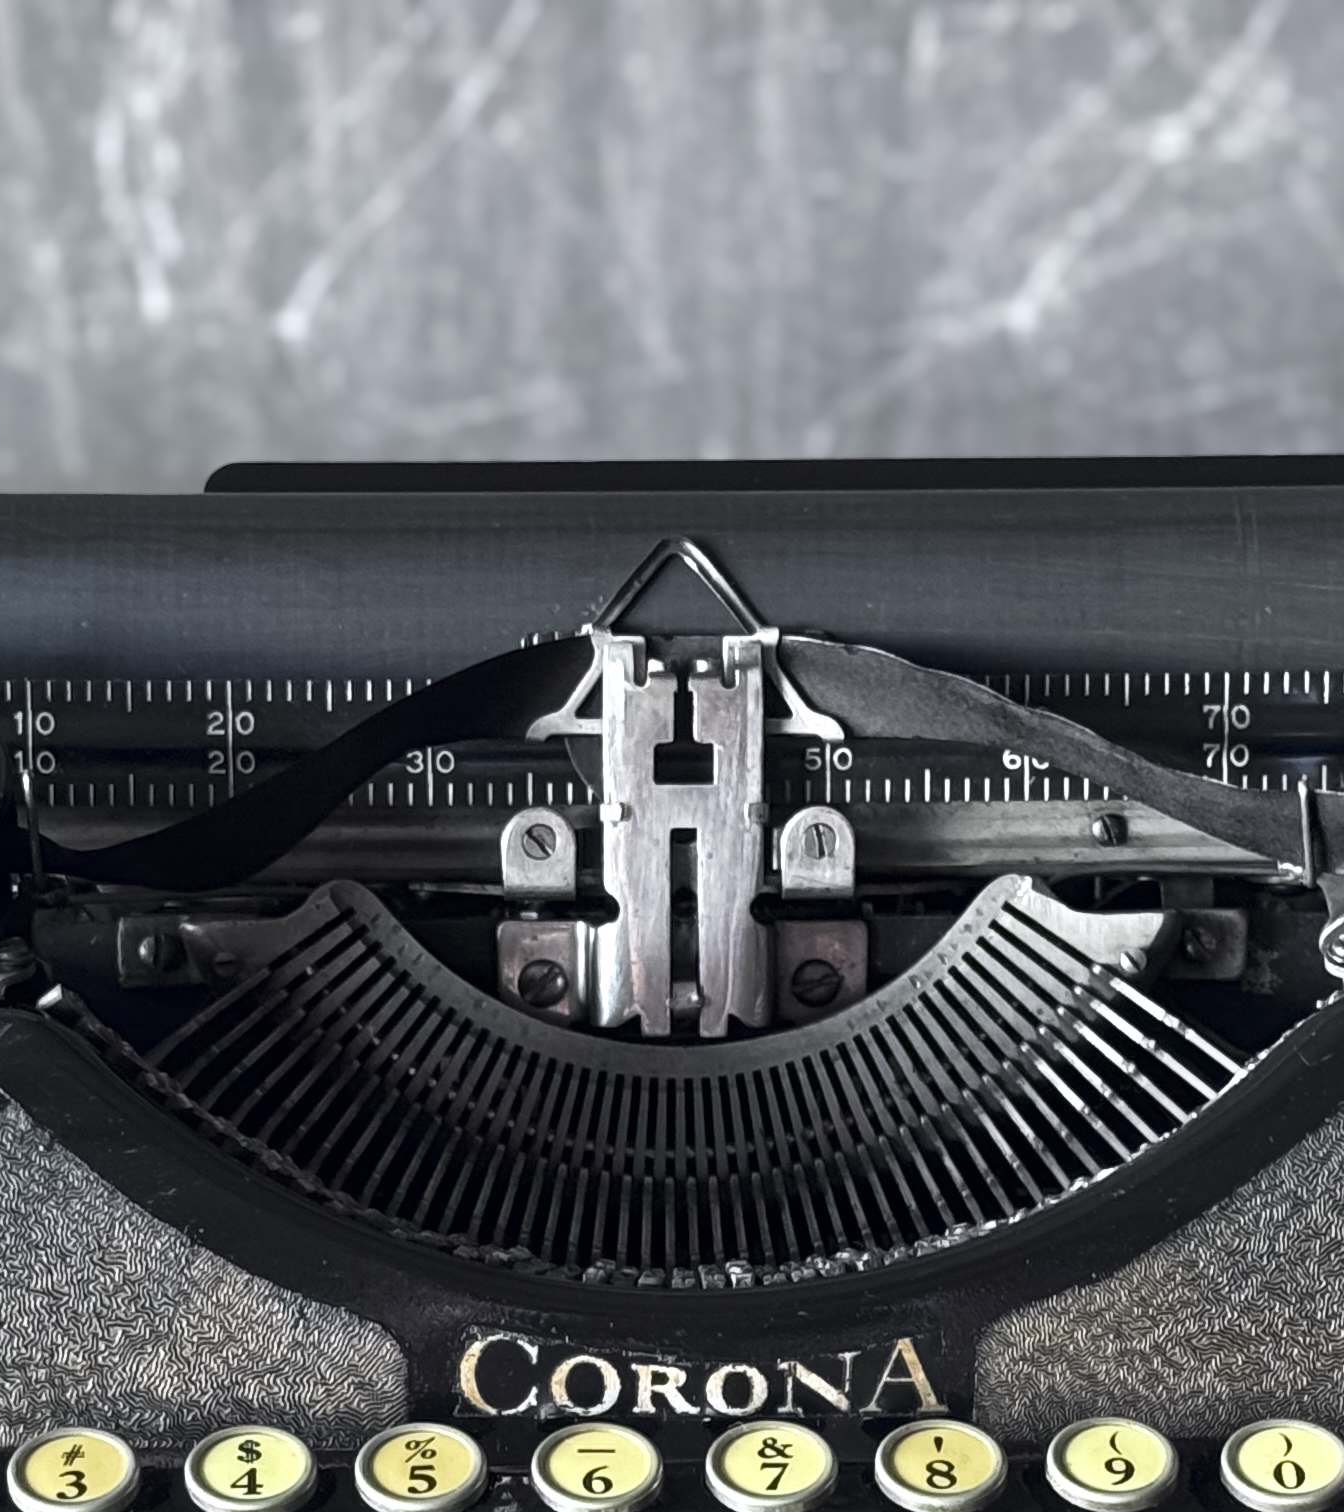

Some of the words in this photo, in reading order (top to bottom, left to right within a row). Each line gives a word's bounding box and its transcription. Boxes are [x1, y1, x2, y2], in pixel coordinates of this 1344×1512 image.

[13, 711, 56, 736] 10
[206, 711, 255, 736] 20
[1203, 704, 1251, 729] 70
[14, 750, 56, 775] 10
[207, 750, 255, 775] 20
[406, 749, 455, 775] 30
[804, 748, 853, 771] 50
[1202, 743, 1250, 768] 70
[458, 1333, 951, 1417] CORONA
[61, 1443, 85, 1467] #
[236, 1439, 263, 1464] $
[404, 1435, 437, 1463] %
[757, 1436, 794, 1459] &
[1109, 1432, 1122, 1455] (
[1283, 1434, 1293, 1457] )
[229, 1467, 264, 1496] 4
[405, 1465, 437, 1495] 5
[581, 1465, 614, 1495] 6
[760, 1462, 789, 1491] 7
[924, 1459, 958, 1491] 8
[1104, 1457, 1136, 1486] 9
[55, 1470, 89, 1500] 3
